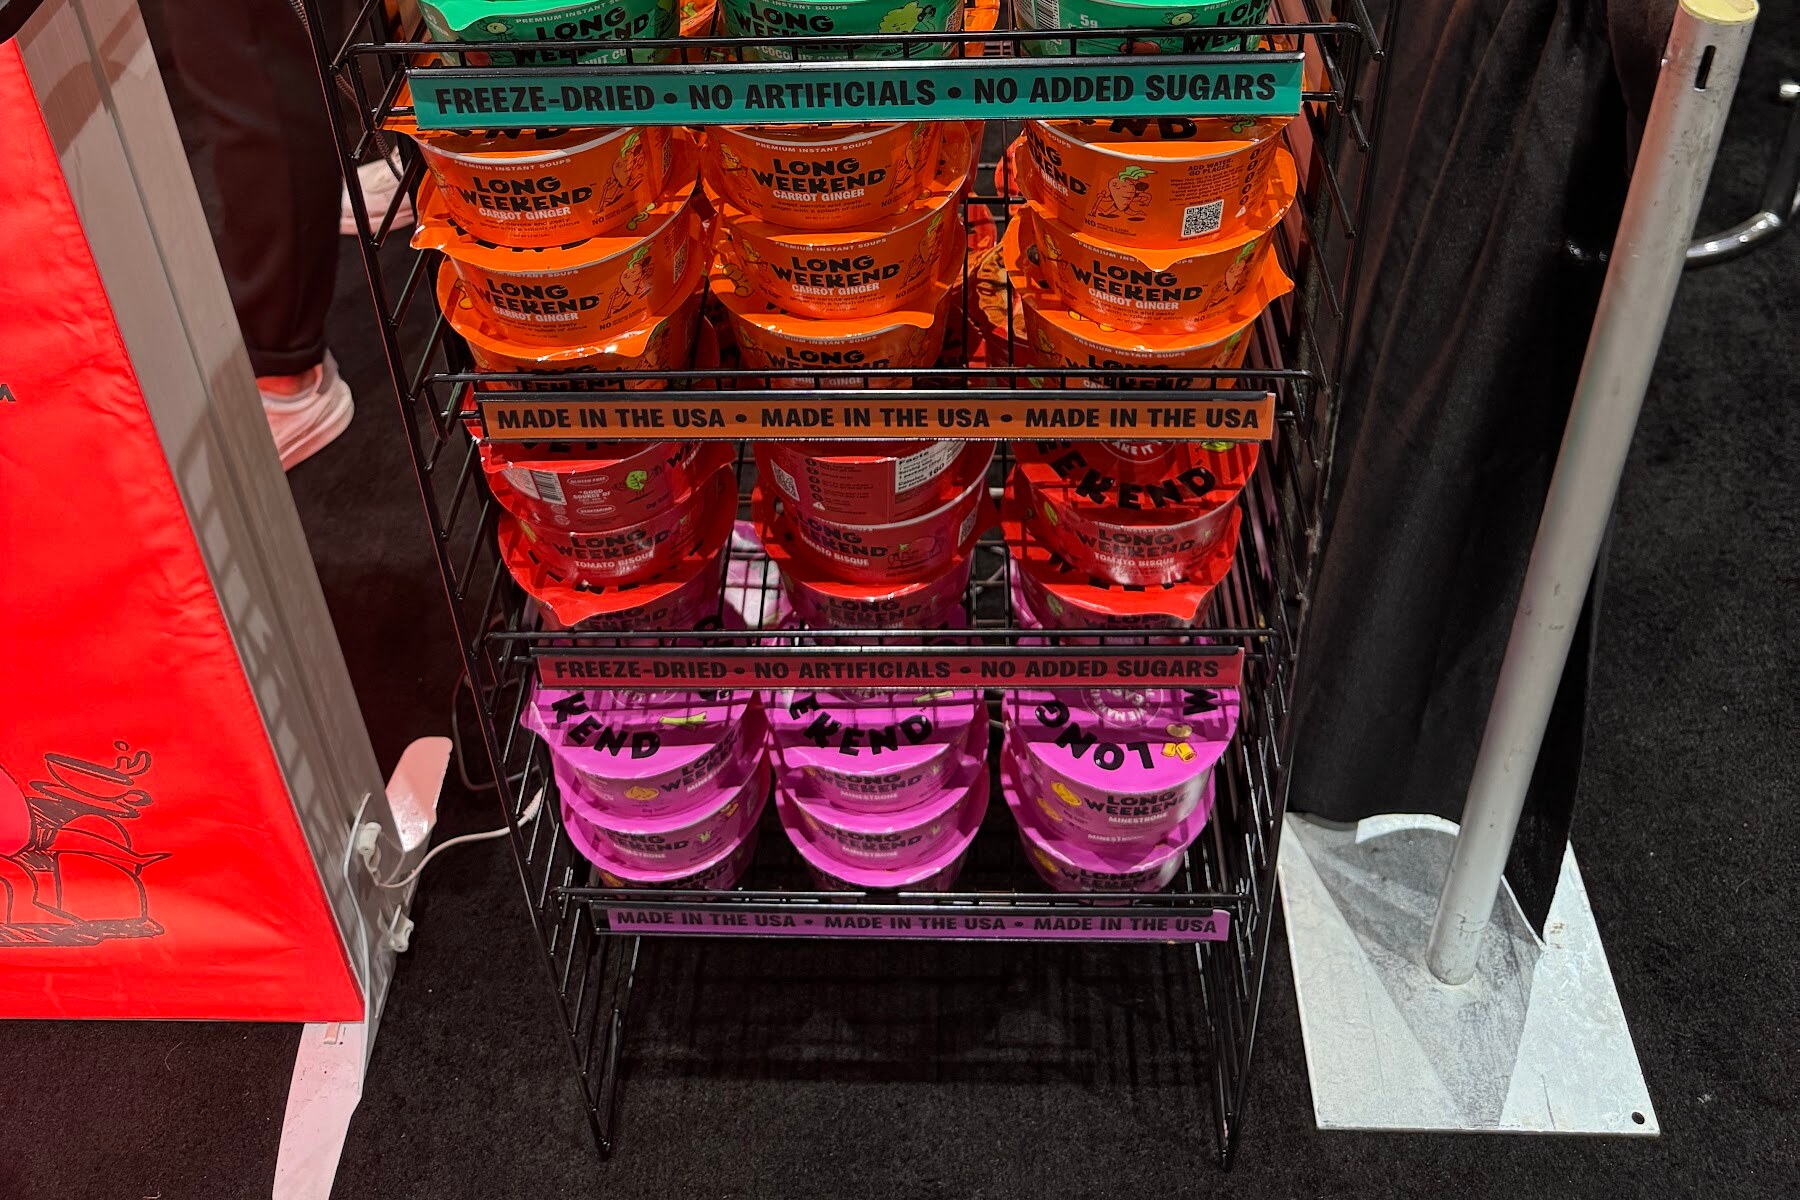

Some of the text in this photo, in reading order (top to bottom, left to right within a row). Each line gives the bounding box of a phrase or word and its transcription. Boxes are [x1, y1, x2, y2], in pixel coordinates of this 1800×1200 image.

[536, 6, 626, 40] LONG
[750, 1, 834, 33] LONG
[435, 73, 1276, 115] FREEZE-DRIED NO ARTIFICIALS NO ADDED SUGARS
[773, 157, 860, 176] LONG
[1188, 164, 1205, 172] ADD
[472, 176, 561, 194] LONG
[751, 168, 886, 194] WEEKEND
[455, 185, 592, 212] WEEKEND
[773, 189, 865, 201] CARROT GINGER
[479, 207, 571, 220] CARROT GINGER
[792, 254, 875, 272] LONG
[771, 262, 900, 288] WEEKEND
[1071, 262, 1203, 301] WEEKEND
[1093, 259, 1178, 287] LONG
[487, 279, 568, 299] LONG
[792, 283, 879, 296] CARROT GINGER
[472, 284, 599, 315] WEEKEND
[1088, 288, 1179, 310] CARROT GINGER
[492, 306, 579, 322] CARROT GINGER
[497, 408, 1258, 429] MADE IN THE USA MADE IN THE USA MADE IN THE USA
[569, 529, 646, 548] LONG
[1099, 528, 1174, 546] LONG
[574, 561, 615, 569] TOMATO
[1094, 552, 1174, 567] TOMATO BISQUE
[555, 660, 1218, 679] FREEZE-DRIED NO ARTIFICIALS NO ADDED SUGARS
[1035, 700, 1154, 770] LONG
[1107, 791, 1176, 805] LONG
[1108, 812, 1168, 824] MINESTRONE
[617, 912, 1216, 933] MADE IN THE USA MADE IN THE USA MADE IN THE USA
